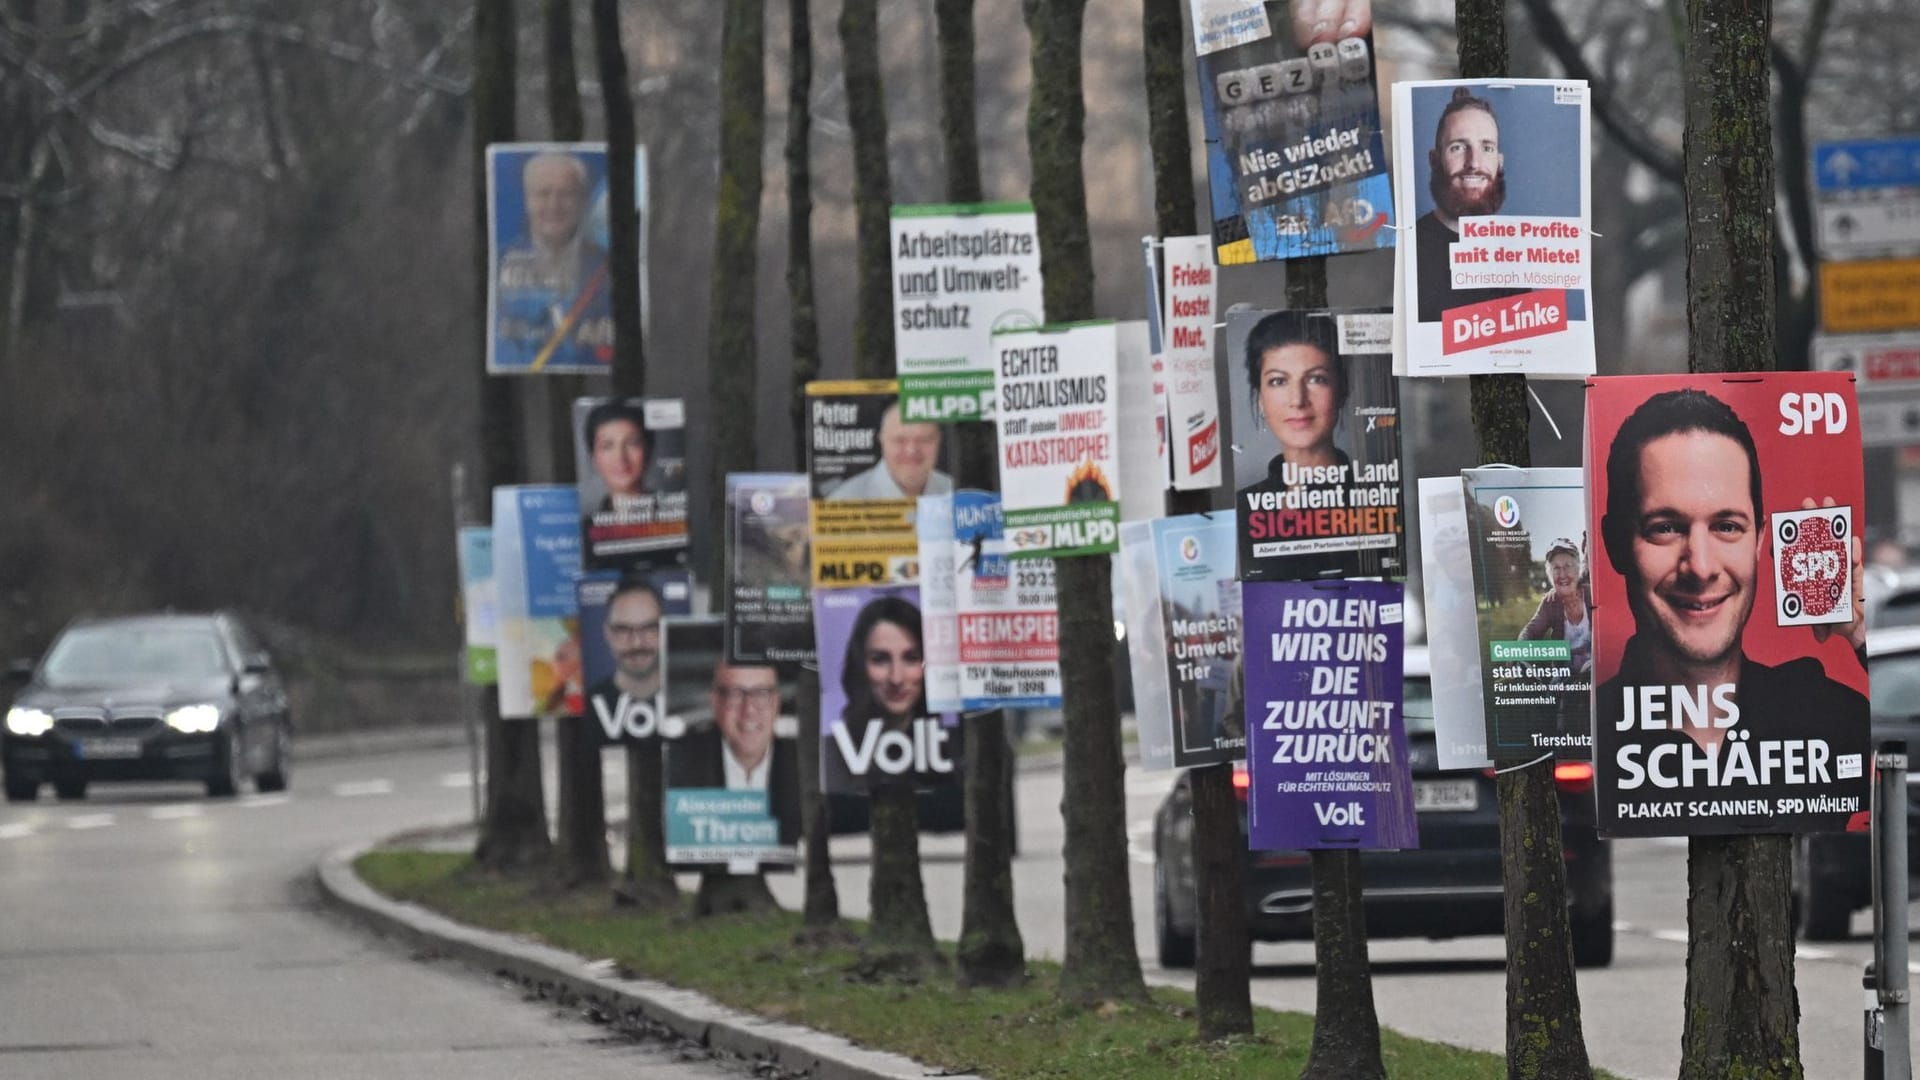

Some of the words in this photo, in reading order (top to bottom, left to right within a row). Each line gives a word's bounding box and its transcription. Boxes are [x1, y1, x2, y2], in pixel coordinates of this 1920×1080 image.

[1239, 148, 1281, 176] Nie
[1284, 127, 1359, 163] wieder
[1248, 148, 1374, 202] abGEZockt!
[1464, 221, 1515, 238] Keine
[1520, 221, 1580, 239] Profite
[900, 229, 1032, 260] Arbeitsplätze
[1454, 247, 1488, 263] mit
[1494, 247, 1522, 263] der
[1527, 247, 1580, 263] Miete!
[901, 267, 938, 293] und
[943, 264, 1028, 293] Umwelt-
[1455, 271, 1520, 286] Christoph
[1523, 272, 1582, 287] Mössinger
[902, 302, 970, 329] schutz
[1453, 313, 1496, 344] Die
[1500, 300, 1560, 333] Linke
[1173, 326, 1206, 350] Mut,
[1001, 345, 1058, 376] ECHTER
[906, 394, 978, 419] MLPD
[1002, 376, 1106, 412] SOZIALISMUS
[812, 401, 858, 425] Peter
[1004, 417, 1027, 436] statt
[1058, 409, 1107, 432] UMWELT-
[1778, 391, 1848, 436] SPD
[813, 427, 874, 452] Rügner
[1005, 434, 1110, 469] KATASTROPHE!
[1282, 461, 1349, 486] Unser
[1352, 458, 1399, 483] Land
[1247, 484, 1344, 511] verdient
[1349, 482, 1400, 508] mehr
[1054, 519, 1117, 549] MLPD
[1248, 506, 1402, 540] SICHERHEIT.
[819, 562, 884, 581] MLPD
[1791, 550, 1840, 583] SPD
[1172, 615, 1237, 637] Mensch
[1282, 598, 1376, 629] HOLEN
[1174, 635, 1240, 659] Umwelt
[1271, 633, 1332, 662] WIR
[1336, 633, 1388, 663] UNS
[1494, 643, 1567, 658] Gemeinsam
[1177, 664, 1211, 681] Tier
[1310, 666, 1359, 696] DIE
[1492, 665, 1522, 678] statt
[1525, 664, 1571, 678] einsam
[1494, 683, 1507, 692] Für
[1509, 682, 1547, 692] Inklusion
[1549, 683, 1564, 691] und
[1495, 696, 1556, 705] Zusammenhalt
[1262, 700, 1394, 730] ZUKUNFT
[1616, 682, 1741, 732] JENS
[831, 718, 954, 775] Volt
[1272, 728, 1391, 764] ZURÜCK
[1531, 733, 1593, 746] Tierschutz
[1616, 728, 1832, 790] SCHÄFER
[1277, 780, 1297, 793] FÜR
[1297, 781, 1334, 793] ECHTEN
[1335, 781, 1392, 793] KLIMASCHUTZ
[1305, 772, 1323, 782] MIT
[1324, 770, 1370, 782] LÖSUNGEN
[1313, 801, 1366, 826] Volt
[1618, 802, 1684, 819] PLAKAT
[1688, 800, 1774, 818] SCANNEN,
[1777, 799, 1804, 815] SPD
[1806, 794, 1860, 814] WÄHLEN!
